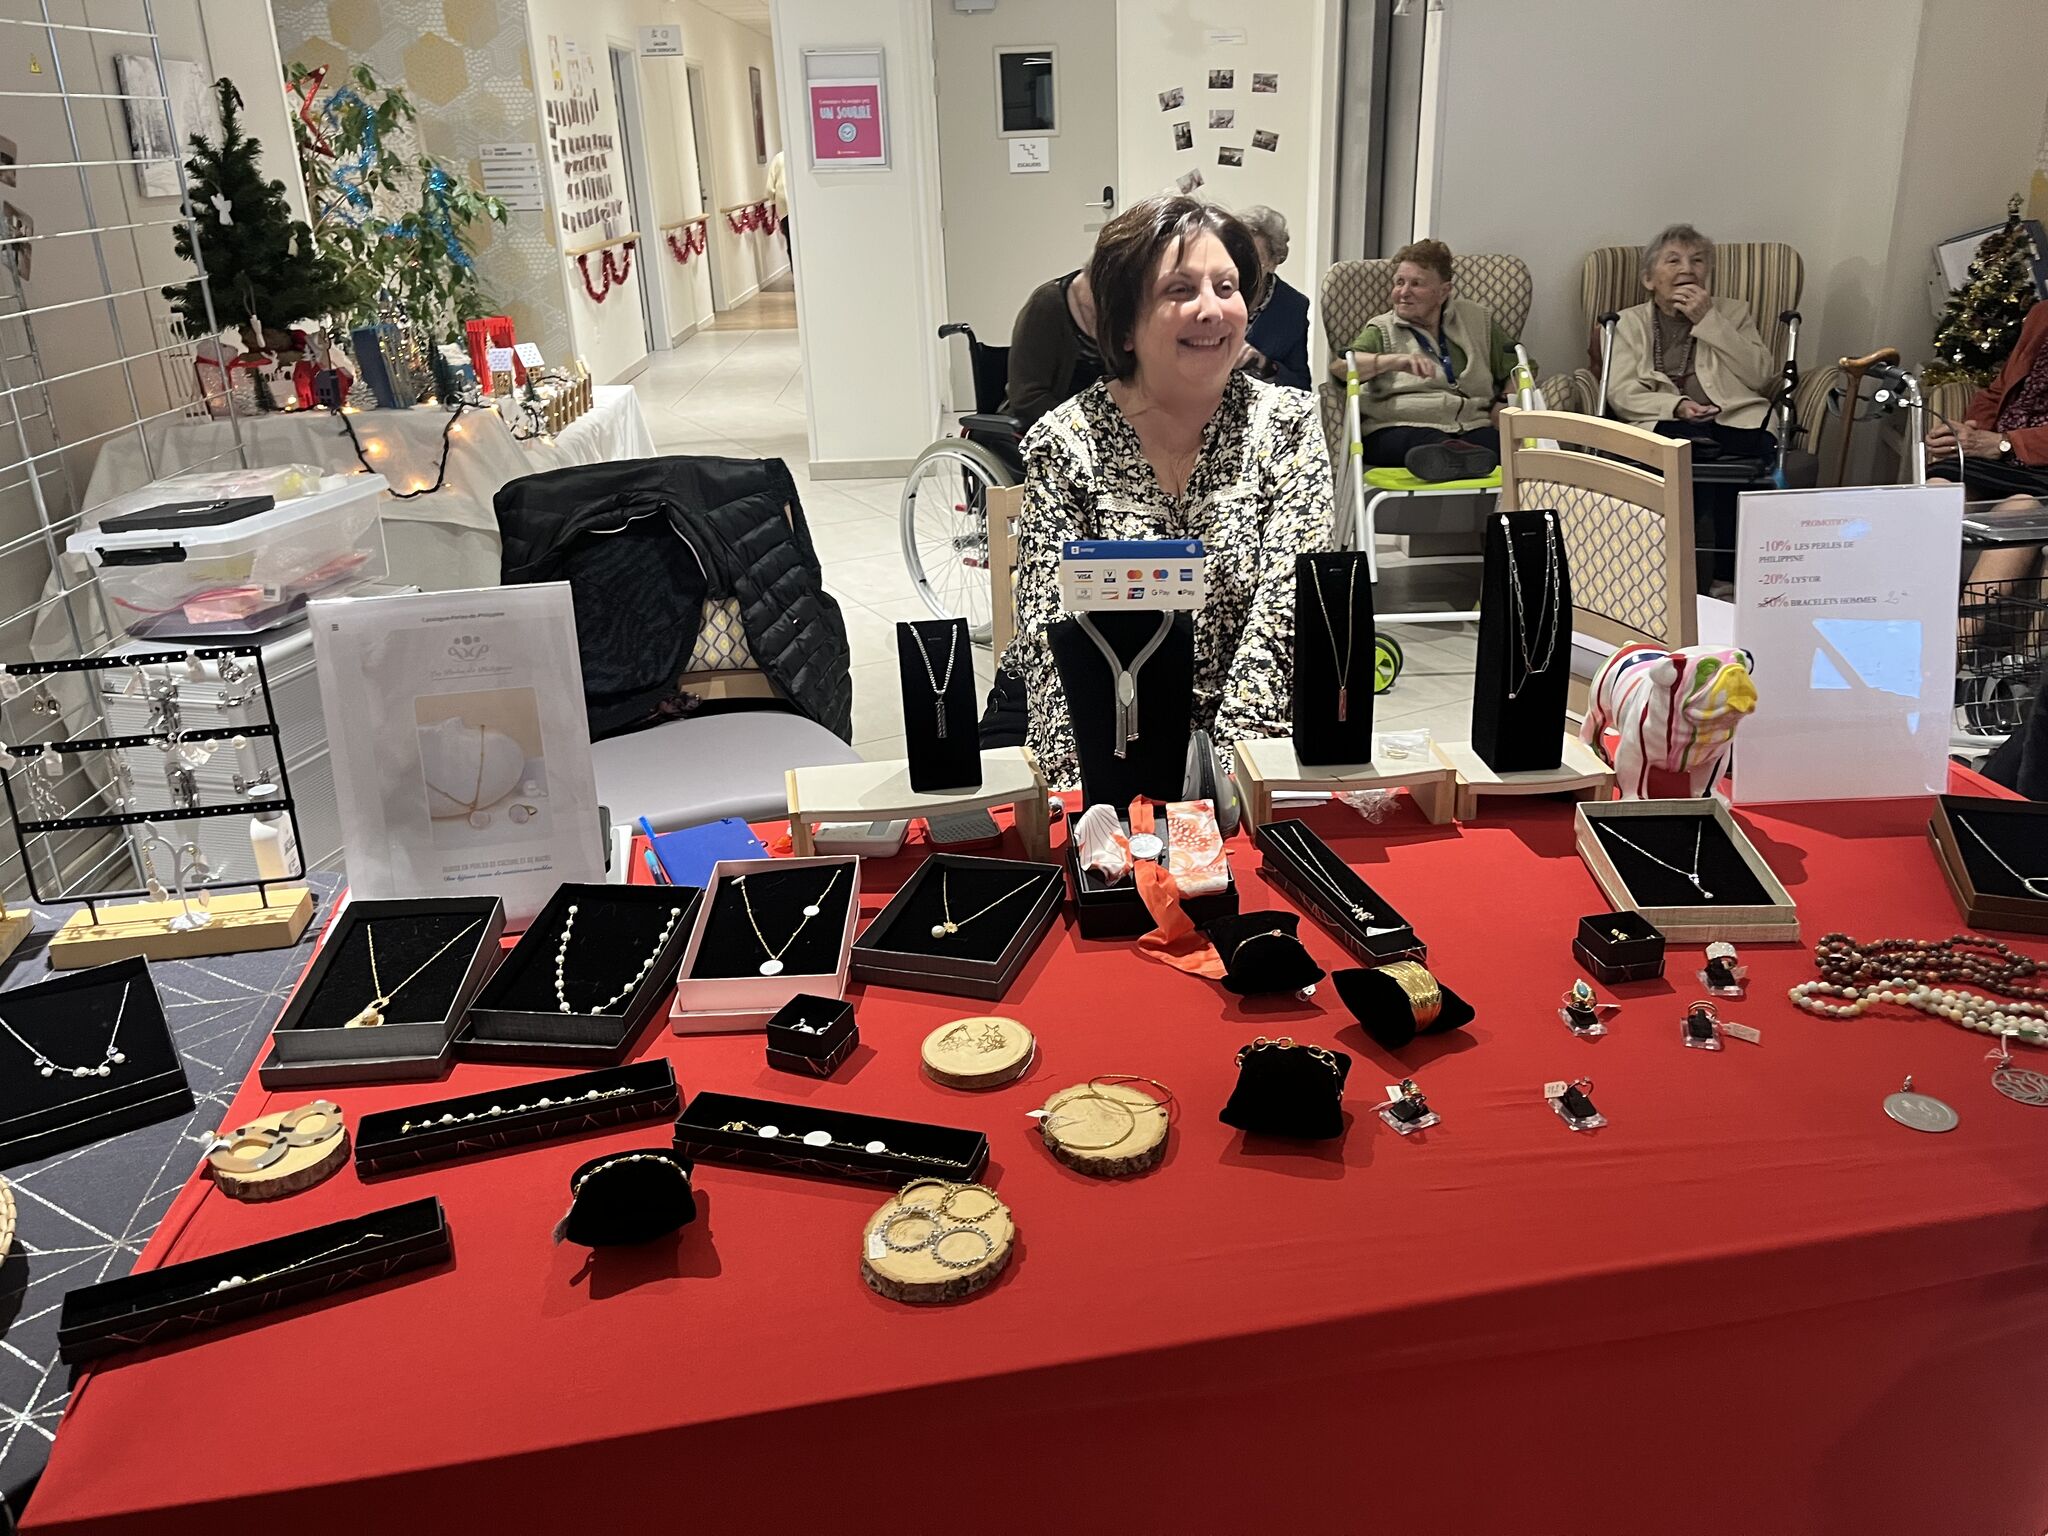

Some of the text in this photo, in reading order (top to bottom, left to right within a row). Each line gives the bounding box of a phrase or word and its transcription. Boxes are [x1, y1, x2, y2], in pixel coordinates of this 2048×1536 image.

[1760, 540, 1791, 552] -10%
[1794, 542, 1810, 551] LES
[1811, 541, 1842, 550] PERLES
[1758, 555, 1805, 564] PHILIPPINE
[1758, 574, 1790, 585] -20%
[1790, 598, 1838, 607] BRACELETS
[1840, 596, 1877, 605] HOMMES
